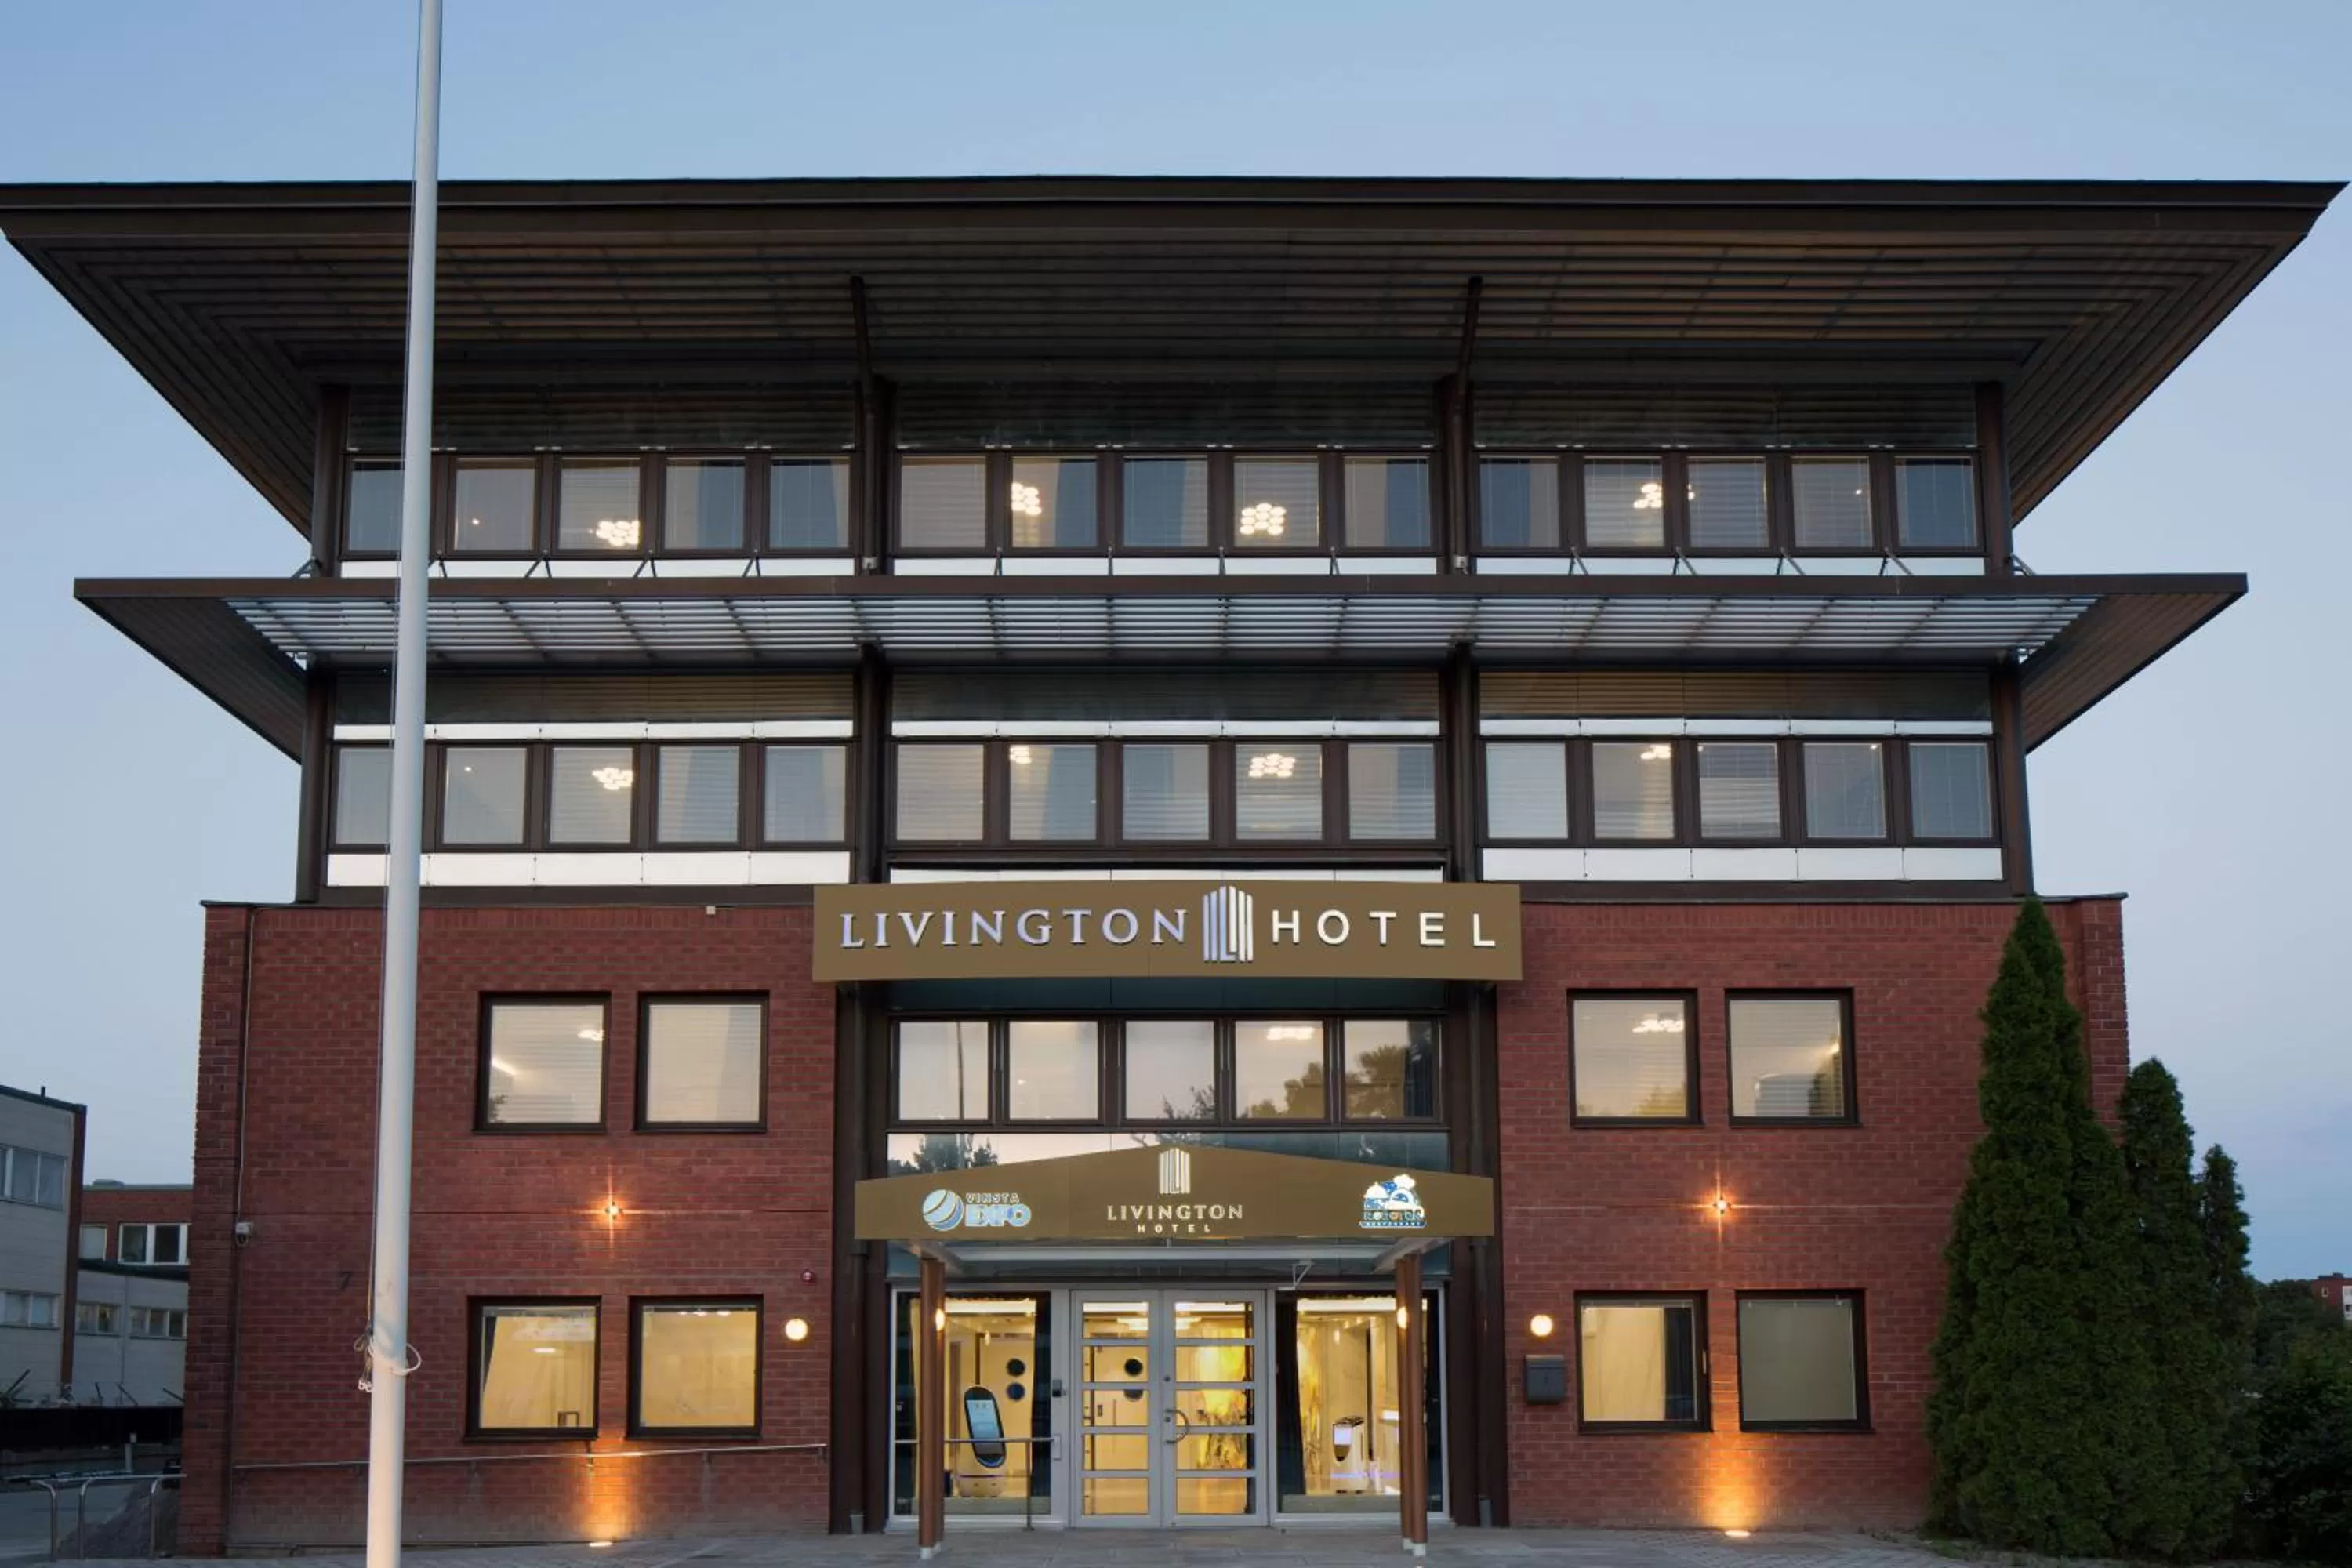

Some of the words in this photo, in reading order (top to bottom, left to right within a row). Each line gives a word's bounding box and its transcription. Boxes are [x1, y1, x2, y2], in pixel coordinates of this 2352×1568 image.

[840, 909, 1188, 948] LIVINGTON
[1272, 909, 1496, 946] HOTEL
[965, 1203, 1031, 1227] EXPO
[1107, 1204, 1243, 1221] LIVINGTON
[1138, 1224, 1211, 1233] HOTEL
